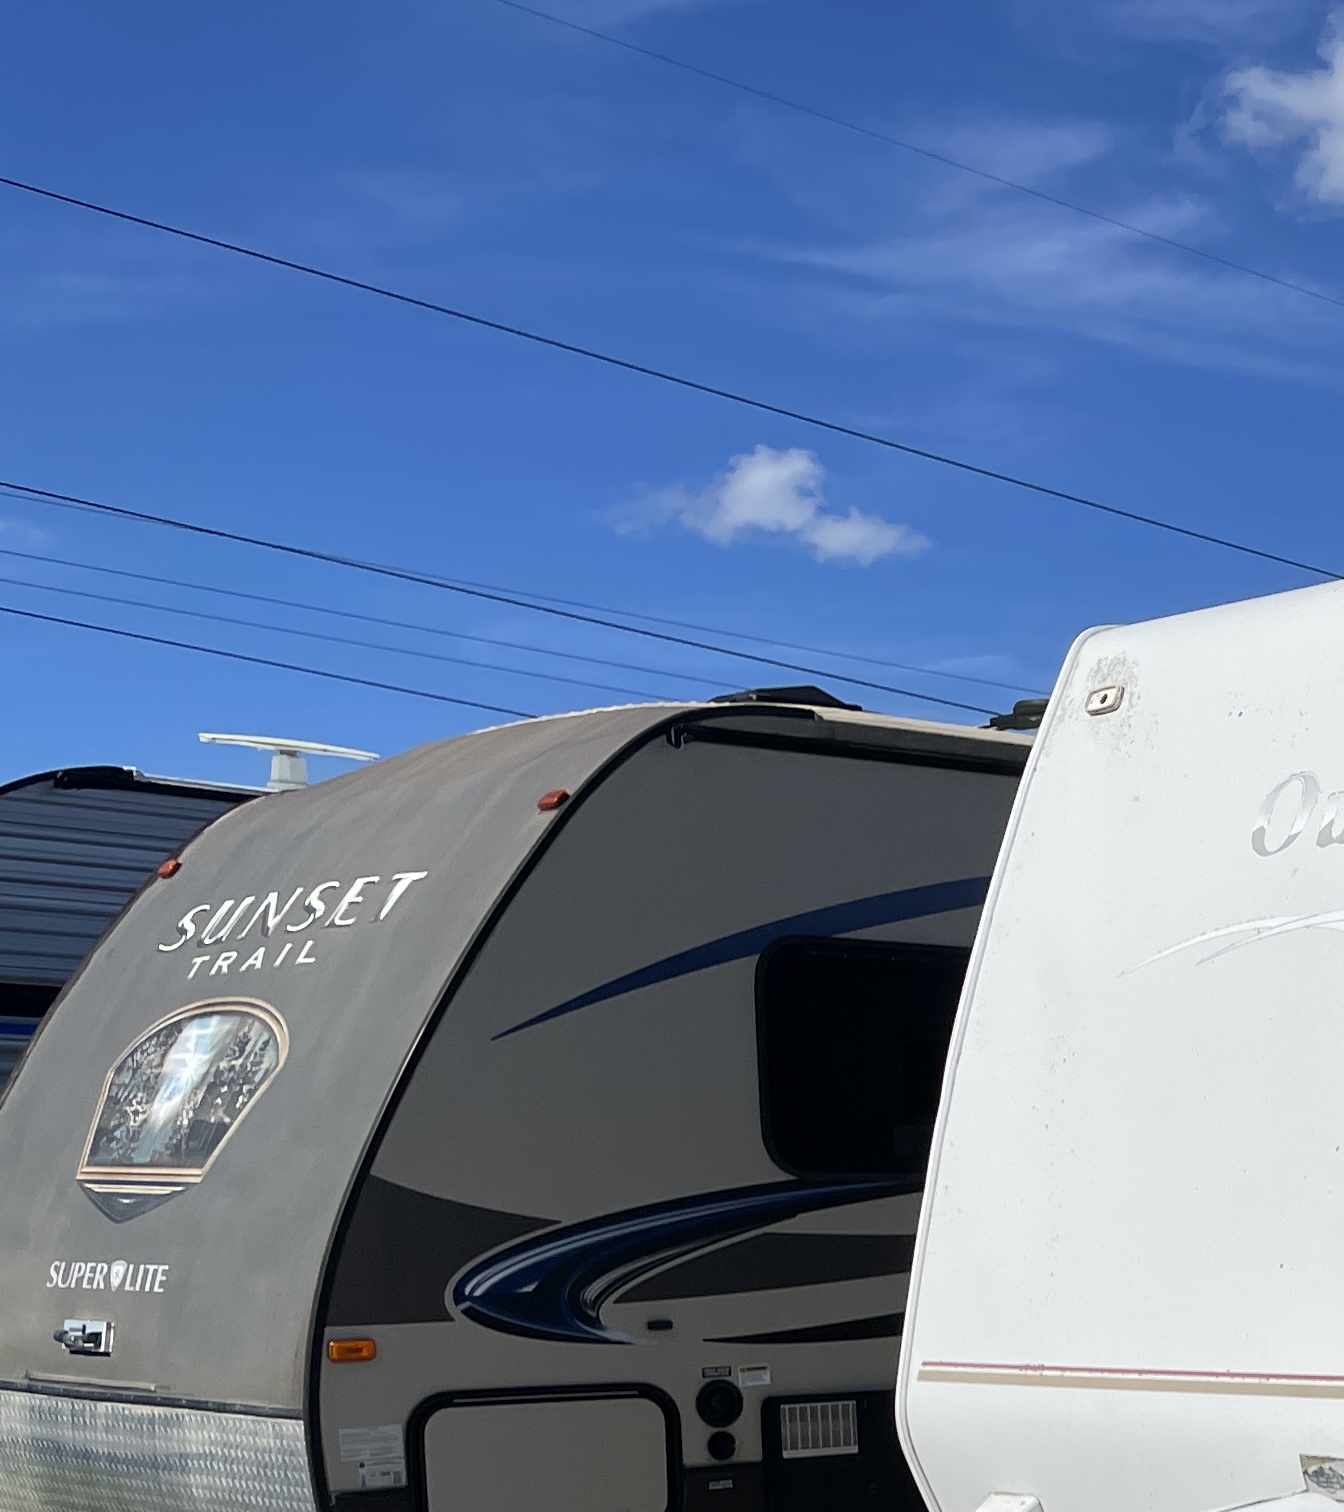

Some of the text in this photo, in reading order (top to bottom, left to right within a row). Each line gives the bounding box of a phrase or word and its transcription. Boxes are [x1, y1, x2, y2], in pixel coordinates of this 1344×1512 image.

[158, 870, 428, 952] SUNSET
[186, 939, 317, 981] TRAIL
[46, 1260, 169, 1293] SUPER LITE
